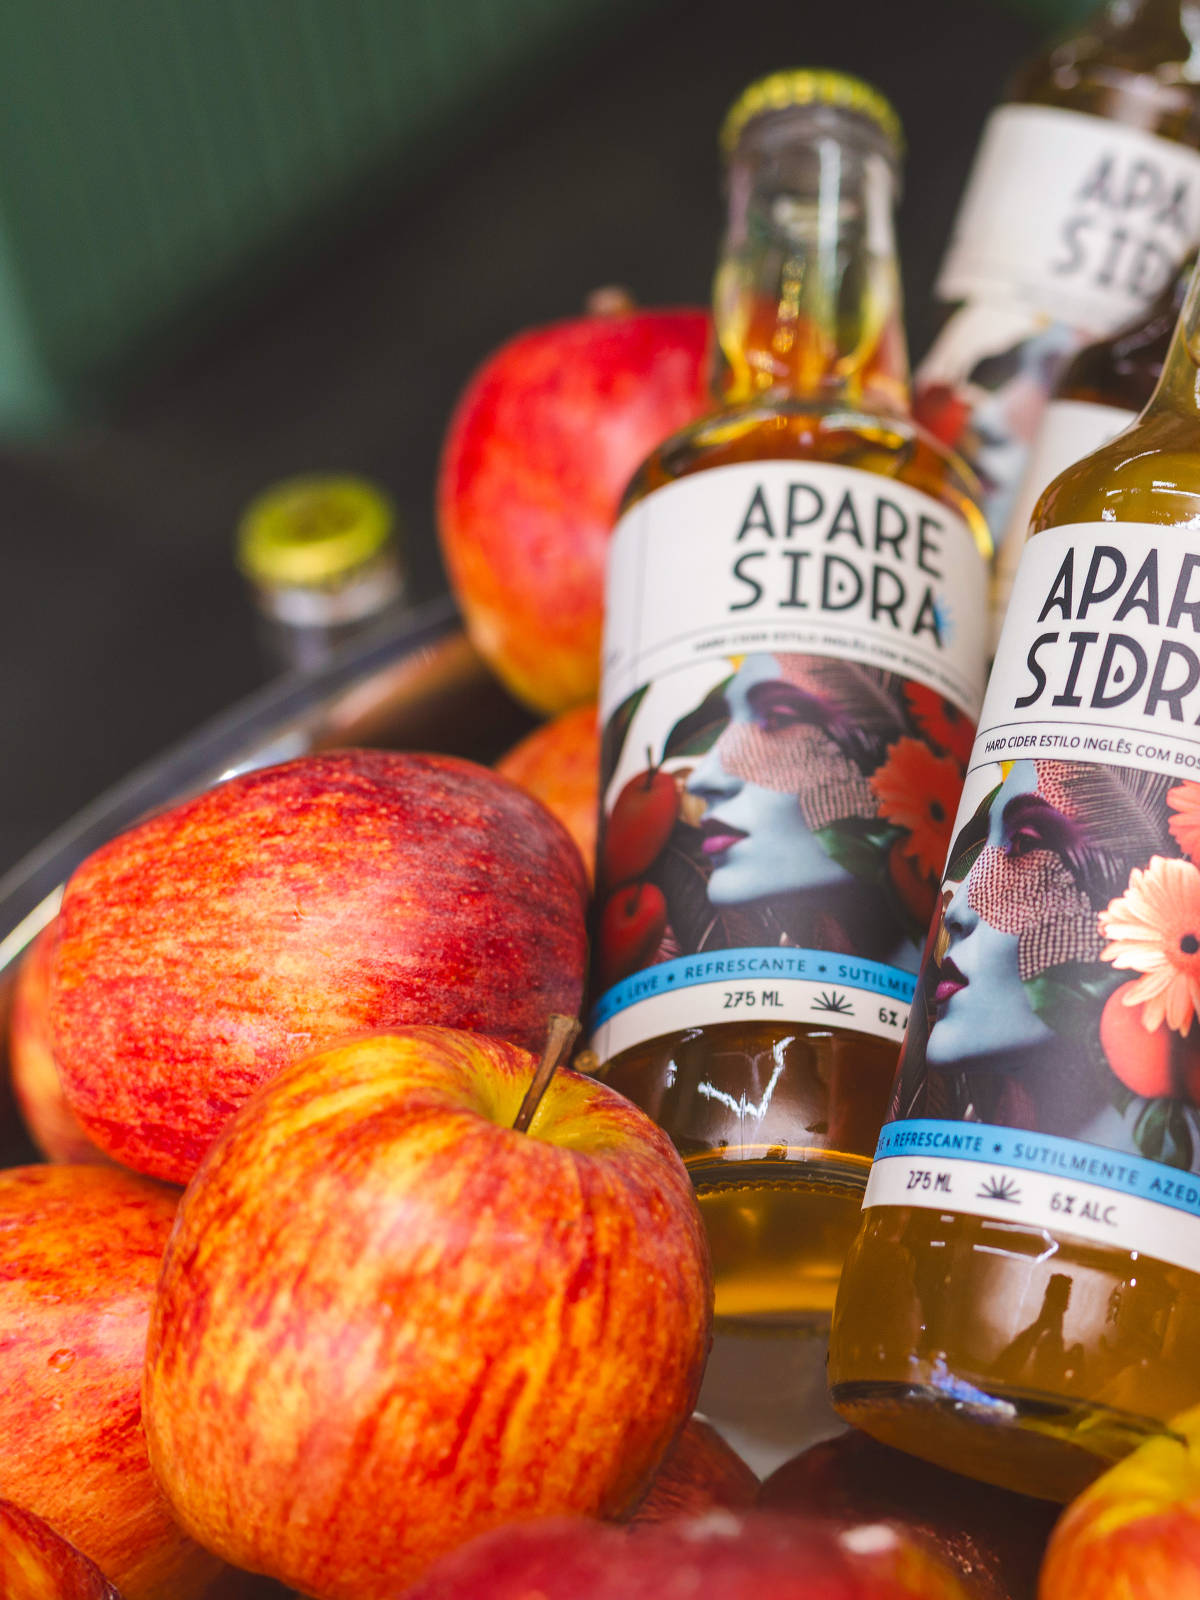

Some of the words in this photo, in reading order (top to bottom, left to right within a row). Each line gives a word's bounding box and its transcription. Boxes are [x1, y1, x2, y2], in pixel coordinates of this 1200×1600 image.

[1076, 152, 1192, 236] APA
[1050, 212, 1172, 296] SID
[735, 483, 944, 579] APARE
[728, 551, 944, 649] SIDRA
[984, 738, 1006, 753] HARD
[1007, 735, 1037, 749] CIDER
[1039, 735, 1080, 748] ESTILO
[1083, 737, 1132, 755] INGLÊS
[1135, 744, 1171, 761] COM
[685, 958, 807, 980] REFRESCANTE
[838, 965, 915, 995] SUTILME
[723, 991, 756, 1009] 275
[762, 990, 784, 1008] ML
[893, 1131, 984, 1152] REFRESCANTE
[1012, 1143, 1141, 1187] SUTILMENTE
[906, 1169, 932, 1190] 275
[934, 1173, 952, 1193] ML
[1080, 1202, 1119, 1228] ALC.
